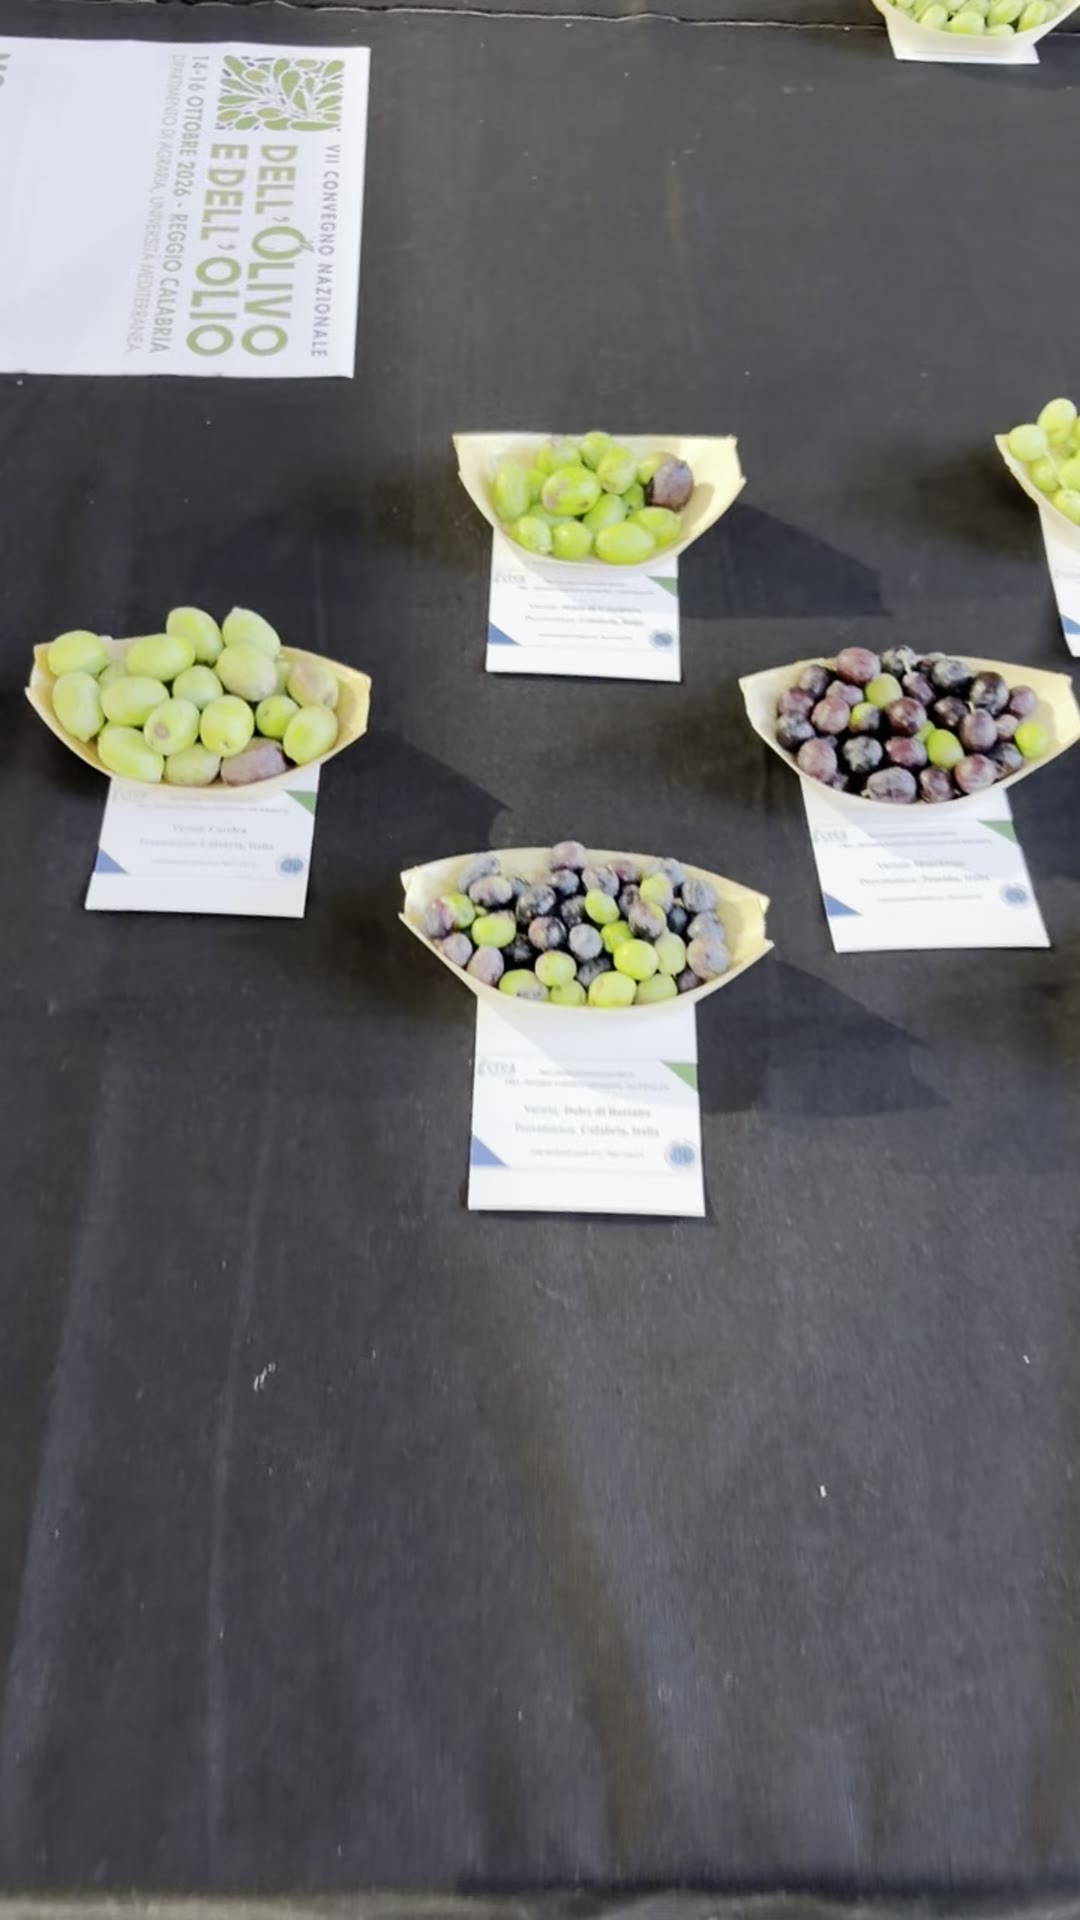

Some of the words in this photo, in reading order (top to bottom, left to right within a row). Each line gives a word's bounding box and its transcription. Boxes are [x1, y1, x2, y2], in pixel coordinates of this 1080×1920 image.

[161, 54, 187, 126] DIPARTIMENTO
[188, 55, 210, 92] 14-16
[160, 129, 175, 140] DI
[180, 96, 205, 156] OTTOBRE
[209, 143, 249, 160] E
[324, 145, 340, 164] VII
[149, 141, 172, 193] AGRARIA,
[173, 161, 196, 198] 2026
[162, 213, 188, 273] REGGIO
[317, 170, 340, 257] CONVEGNO
[186, 169, 246, 357] DELL'OLIO
[125, 264, 155, 353] MEDITERRANEA
[149, 277, 180, 355] CALABRIA
[311, 263, 334, 357] NAZIONALE
